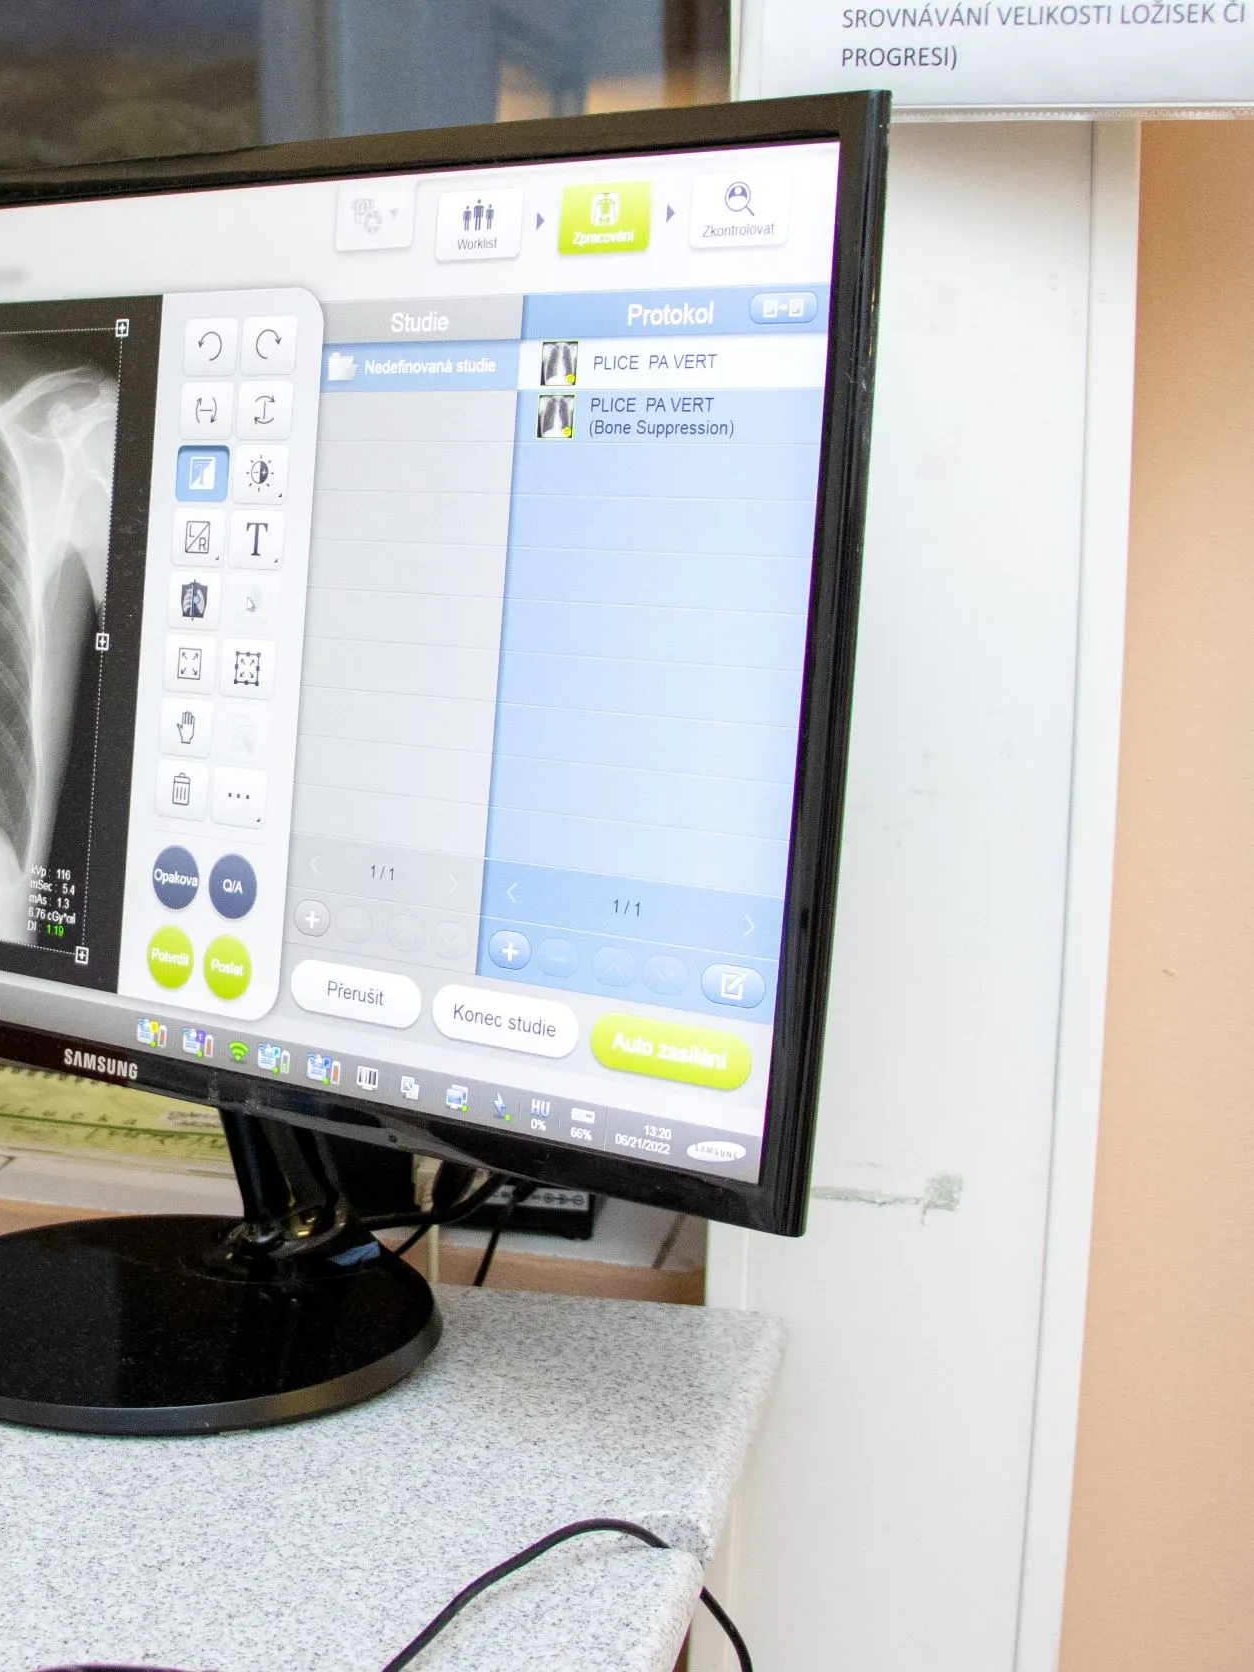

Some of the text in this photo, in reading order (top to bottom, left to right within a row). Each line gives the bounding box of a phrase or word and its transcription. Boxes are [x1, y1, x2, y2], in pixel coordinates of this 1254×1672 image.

[842, 0, 1246, 28] SROVNÁVÁNÍ VELIKOSTI LOŽISEK ČI
[841, 45, 958, 71] PROGRESI)
[702, 222, 775, 238] Zkontrolovat
[457, 237, 498, 251] Worklist
[390, 311, 450, 333] Studie
[626, 301, 715, 327] Protokol
[364, 357, 497, 375] Nedefinovaná studie
[593, 353, 719, 371] PLICE PA VERT
[590, 396, 715, 413] PLICE PA VERT
[588, 418, 735, 438] (Bone Suppression)
[56, 868, 71, 881] 116
[30, 879, 53, 892] mSec
[62, 883, 76, 896] 5.4
[222, 878, 244, 894] Q/A
[29, 893, 48, 906] mAs
[57, 897, 70, 909] 1.3
[28, 906, 47, 920] 6.76
[46, 923, 65, 937] 1.19
[210, 957, 244, 977] Poslat
[327, 980, 384, 1006] Přerušit
[453, 1003, 557, 1037] Konec studie
[611, 1031, 654, 1056] Auto
[63, 1048, 138, 1080] SAMSUNG
[530, 1098, 550, 1118] HU
[530, 1118, 547, 1132] 0%
[570, 1126, 593, 1141] 66%
[643, 1124, 672, 1140] 13:20
[615, 1132, 671, 1155] 06/21/2022
